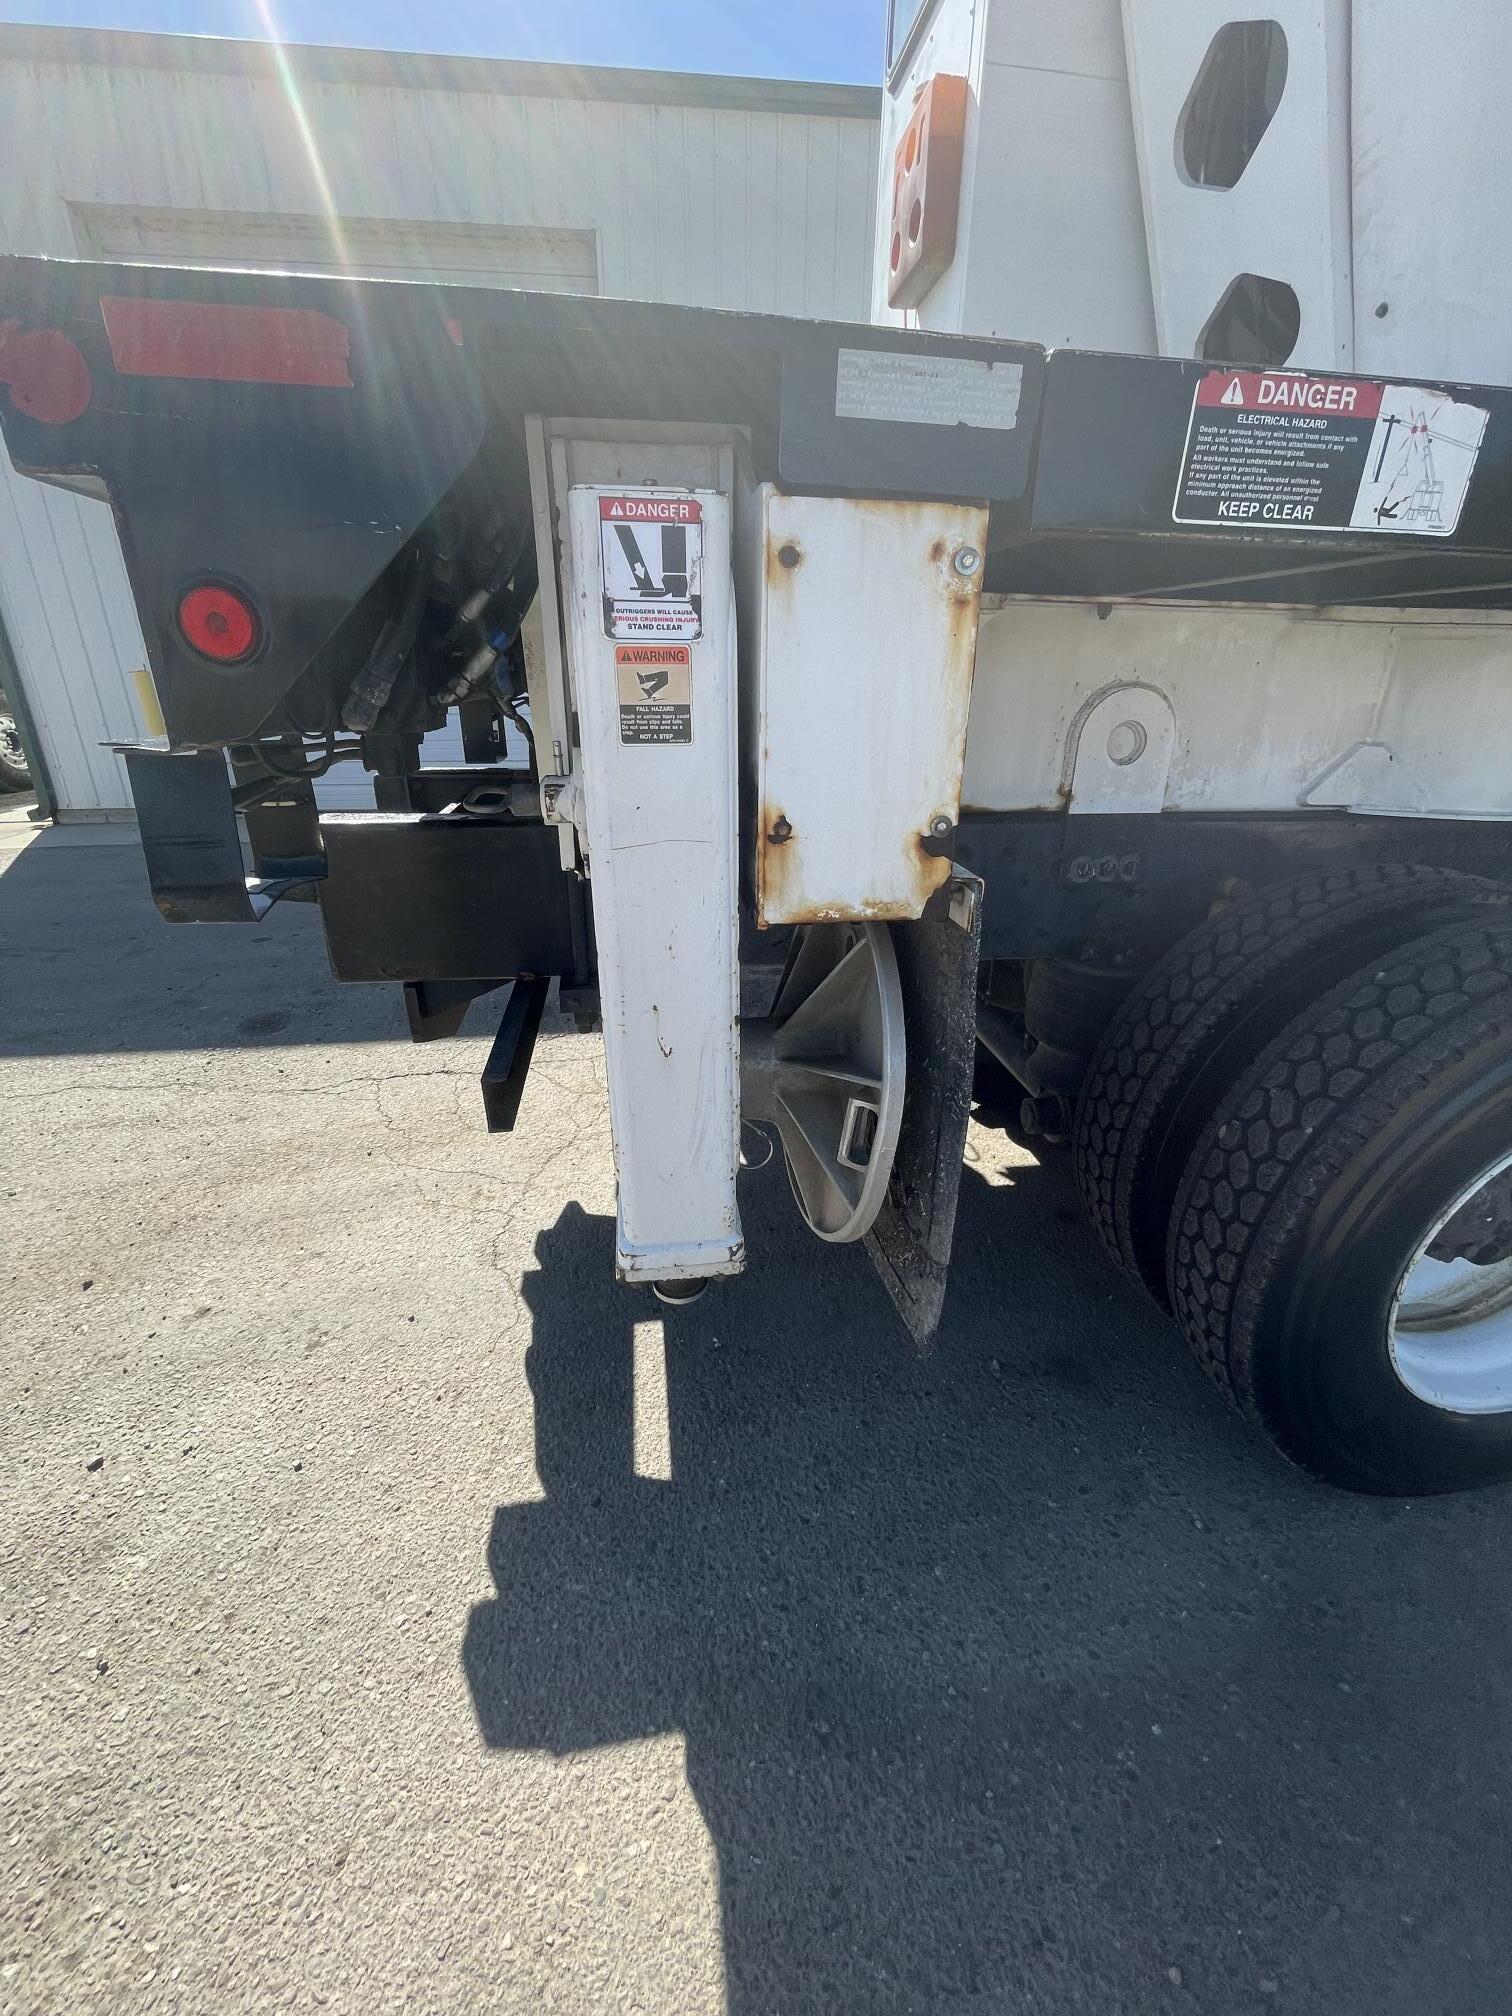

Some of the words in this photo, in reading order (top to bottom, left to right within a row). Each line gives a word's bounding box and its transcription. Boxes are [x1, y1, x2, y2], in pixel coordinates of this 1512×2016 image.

[1258, 380, 1358, 410] DANGER
[1238, 414, 1290, 426] ELECTRICAL
[1292, 418, 1327, 429] HAZARD
[1200, 425, 1218, 433] Death
[1228, 428, 1251, 436] serious
[1253, 428, 1272, 438] injury
[1273, 430, 1284, 438] will
[1285, 431, 1304, 439] result
[1305, 432, 1320, 440] from
[1321, 434, 1344, 442] contact
[1198, 435, 1213, 443] load,
[1215, 436, 1229, 444] unit,
[1231, 437, 1254, 445] vehicle,
[1265, 438, 1287, 447] vehicle
[1288, 440, 1325, 449] attachments
[1327, 442, 1332, 450] if
[1332, 444, 1344, 452] any
[1244, 447, 1272, 455] becomes
[1273, 449, 1305, 458] energized.
[1203, 455, 1228, 463] workers
[1247, 458, 1281, 466] understand
[1283, 459, 1294, 467] and
[1296, 460, 1314, 468] follow
[1191, 463, 1220, 471] electrical
[1238, 466, 1269, 475] practices.
[1195, 473, 1207, 481] any
[1208, 473, 1222, 481] part
[1263, 476, 1289, 484] elevated
[1290, 477, 1309, 485] within
[1188, 481, 1216, 489] minimum
[1218, 482, 1246, 492] approach
[1248, 484, 1274, 492] distance
[1292, 486, 1322, 495] energized
[1186, 489, 1219, 497] conductor.
[1231, 492, 1272, 500] unauthorized
[1273, 494, 1302, 502] personnel
[626, 502, 689, 517] DANGER
[1218, 500, 1259, 517] KEEP
[1262, 504, 1314, 520] CLEAR
[633, 650, 684, 661] WARNING
